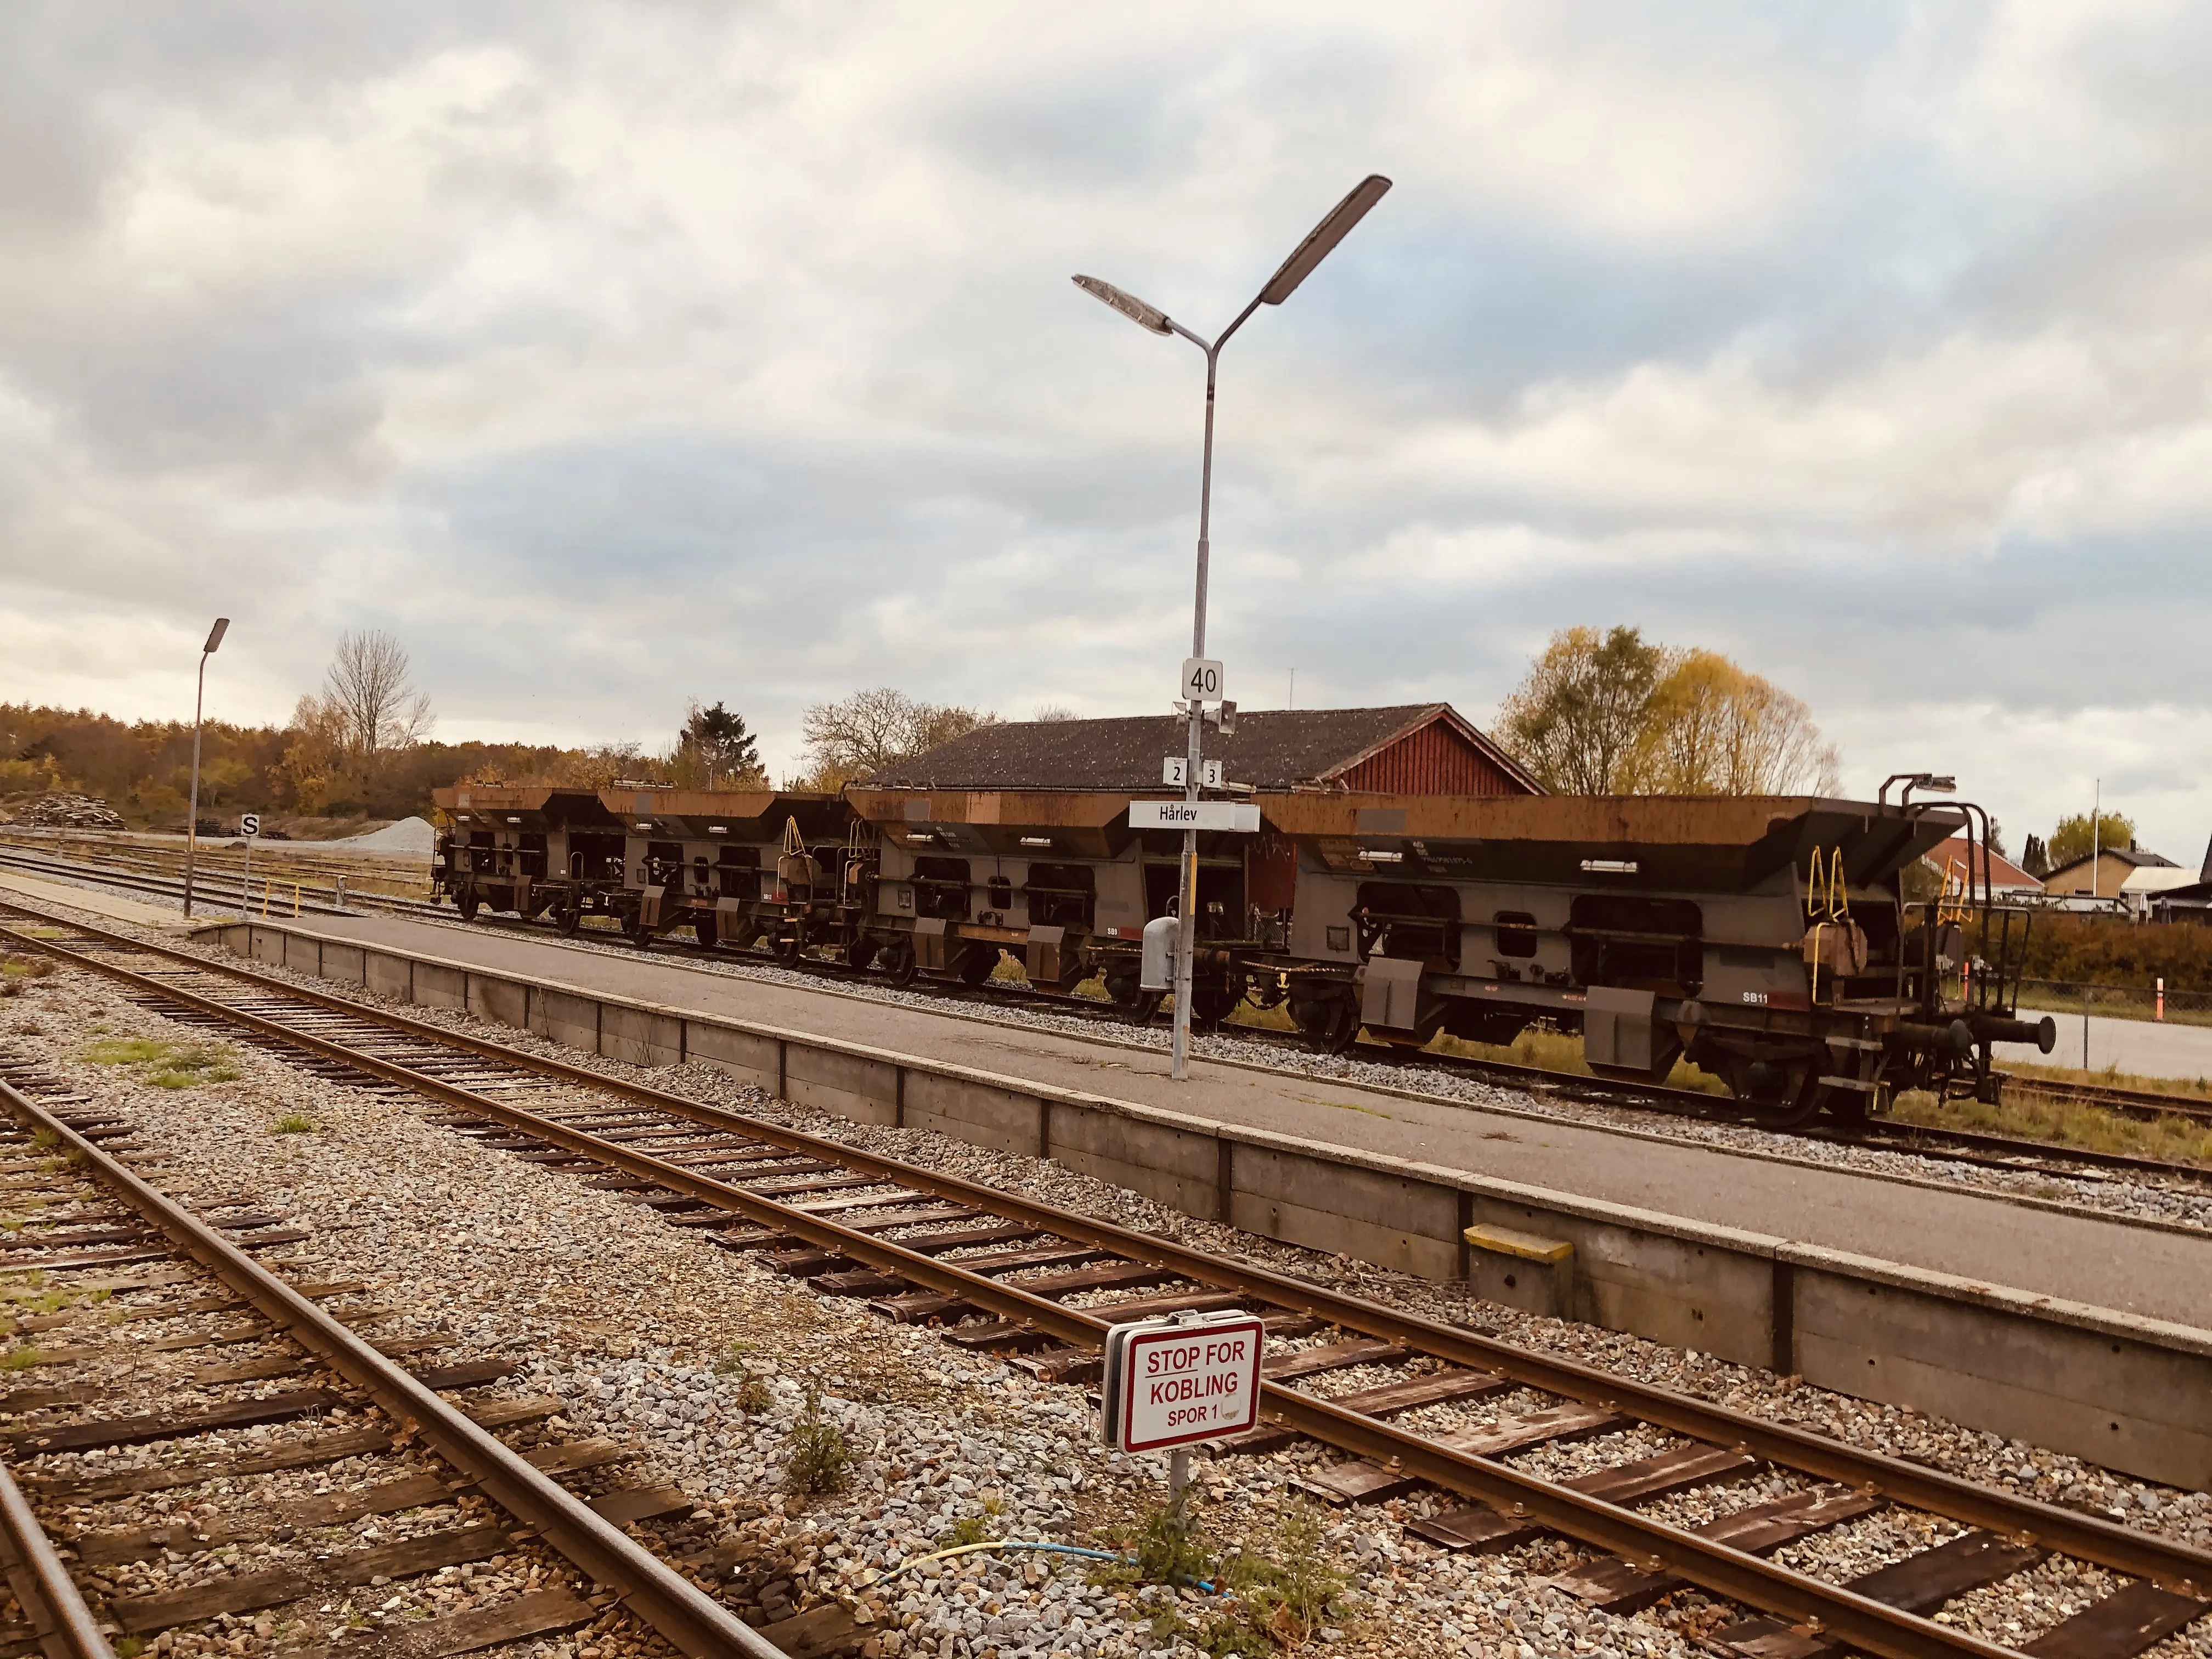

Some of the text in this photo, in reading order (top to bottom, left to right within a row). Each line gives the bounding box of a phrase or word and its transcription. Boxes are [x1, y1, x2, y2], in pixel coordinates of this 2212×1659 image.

[1190, 667, 1216, 693] 40
[1173, 766, 1181, 781] 2
[1209, 769, 1216, 783] 3
[1160, 805, 1197, 821] Hårlev
[242, 816, 258, 835] S
[1743, 991, 1768, 1004] SB11
[1147, 1340, 1245, 1373] STOP FOR
[1150, 1372, 1238, 1404] KOBLING
[1167, 1404, 1217, 1427] SPOR 1
